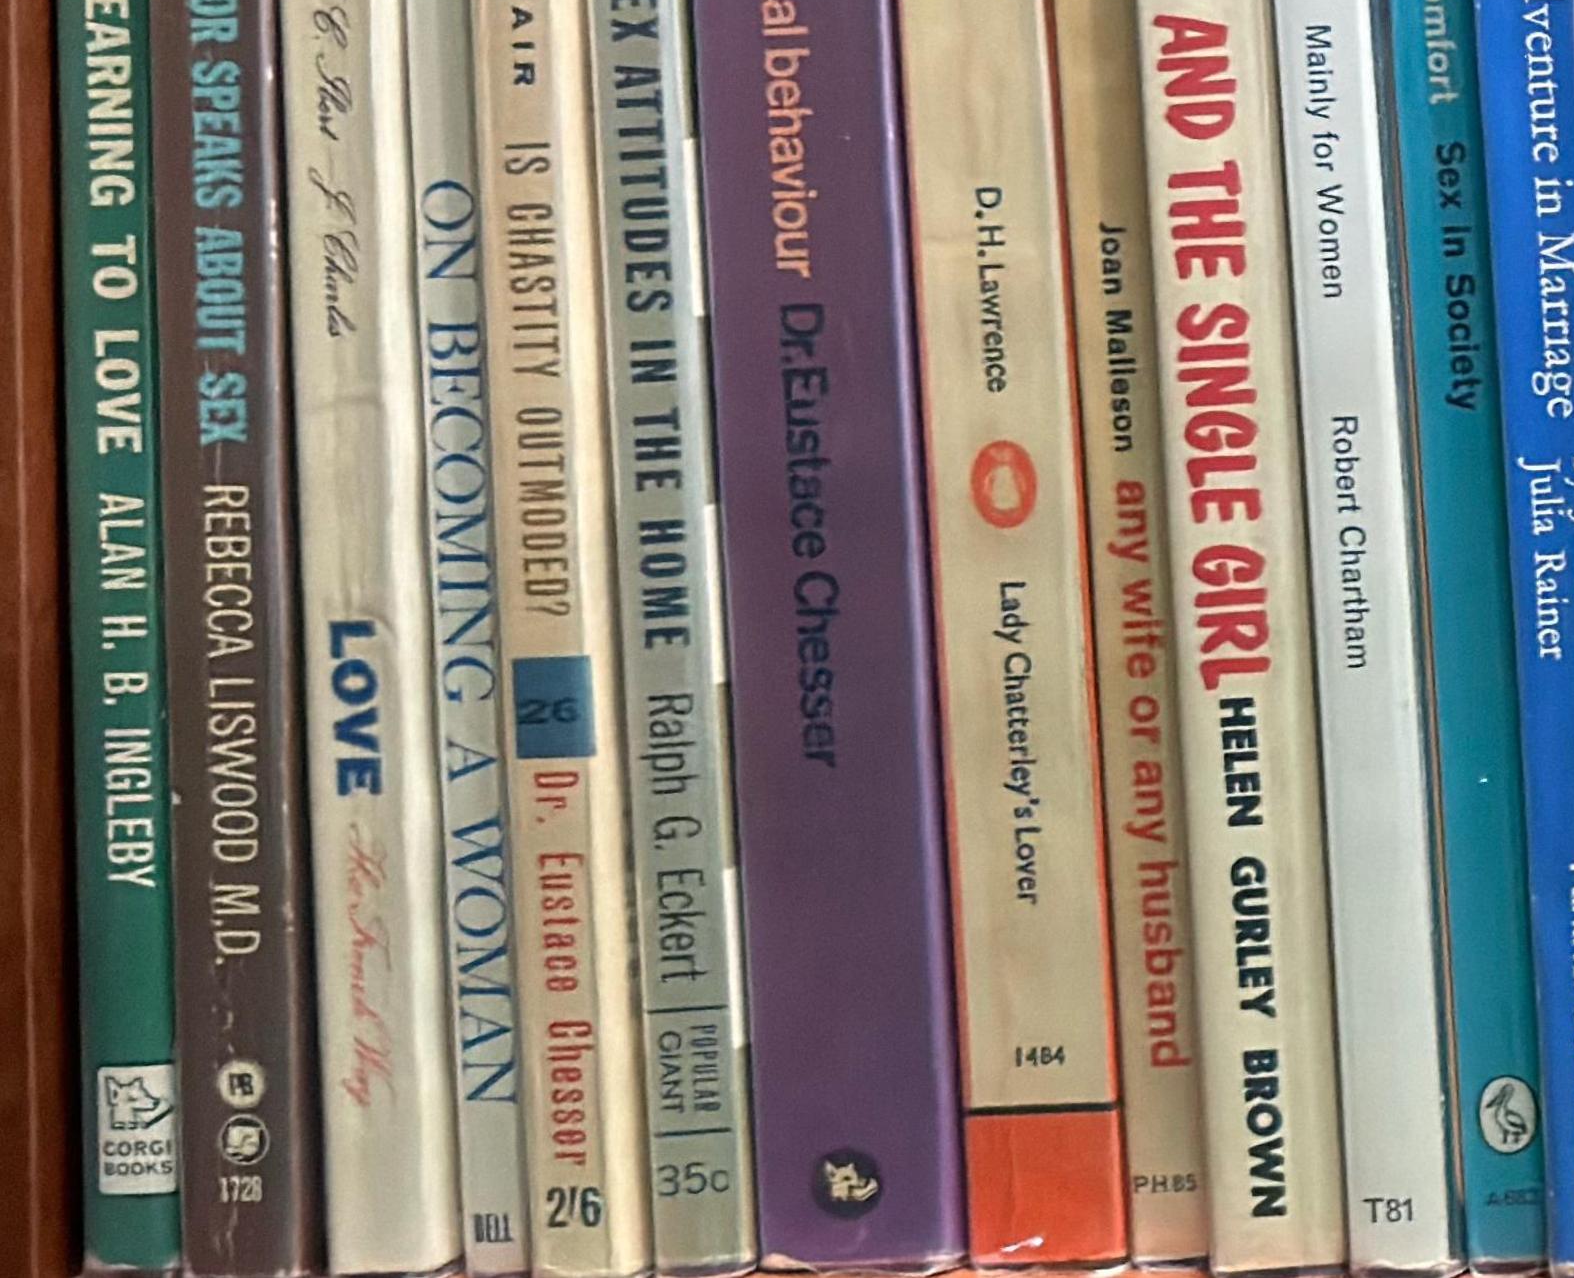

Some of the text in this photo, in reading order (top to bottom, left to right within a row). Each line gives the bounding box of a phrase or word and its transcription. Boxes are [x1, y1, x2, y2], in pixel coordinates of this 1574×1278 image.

[1152, 15, 1237, 140] AND
[614, 65, 669, 314] ATTITUDES
[767, 44, 818, 278] behaviour
[1166, 160, 1246, 279] THE
[1305, 25, 1345, 298] Mainly for Women
[91, 234, 137, 299] TO
[91, 328, 142, 455] LOVE
[630, 341, 676, 384] IN
[1176, 303, 1262, 524] SINGLE
[633, 406, 682, 491] THE
[421, 179, 517, 1105] ON BECOMING A WOMAN
[638, 516, 690, 650] HOME
[1190, 544, 1271, 690] GIRL
[204, 484, 262, 967] REBECCA LISWOOD M.D.
[330, 620, 380, 797] LOVE
[993, 582, 1042, 905] Lady Chatterley's Lover
[534, 770, 590, 1169] Dr. Eustace Chesser
[1216, 695, 1285, 1218] HELEN GURLEY BROWN
[1015, 1045, 1065, 1066] 1484
[104, 1140, 173, 1158] CORGI
[104, 1160, 173, 1176] BOOKS
[1364, 1198, 1413, 1222] T81
